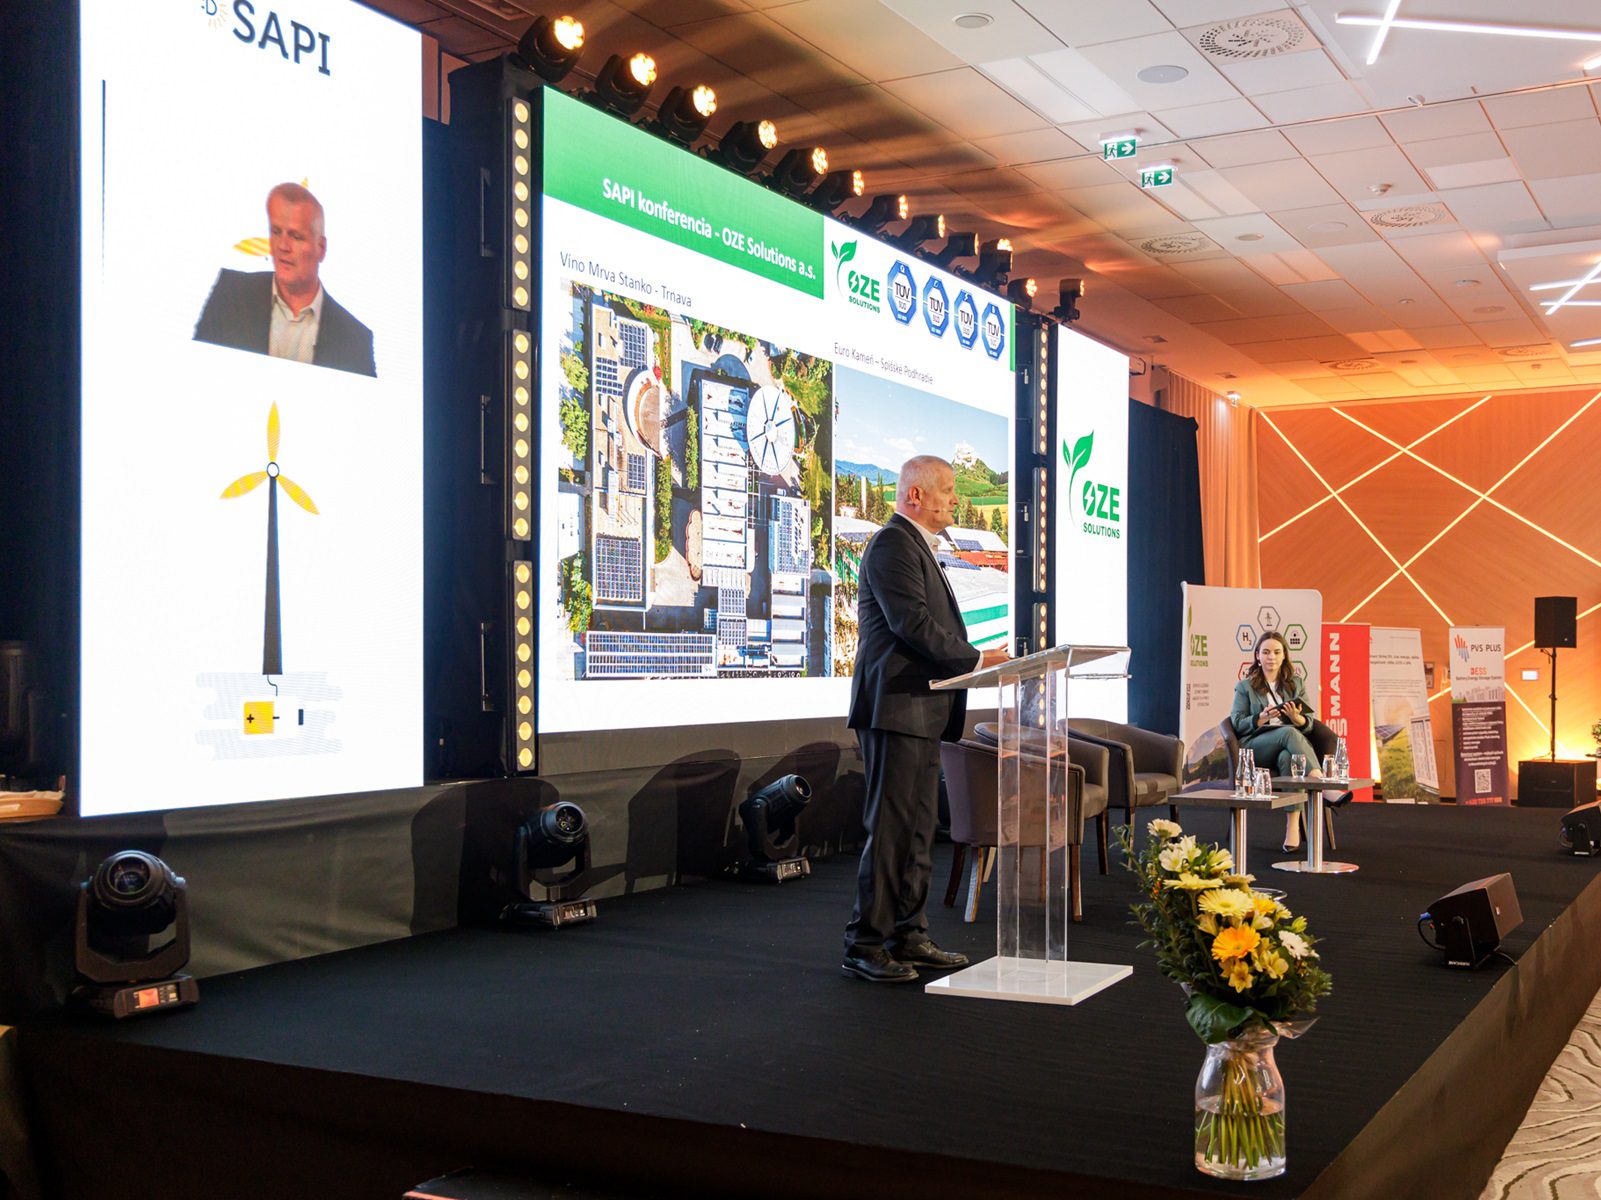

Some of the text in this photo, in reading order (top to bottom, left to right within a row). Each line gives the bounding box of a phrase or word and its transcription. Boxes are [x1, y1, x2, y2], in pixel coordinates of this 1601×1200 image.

[232, 0, 331, 76] SAPI
[602, 178, 635, 208] SAPI
[638, 191, 712, 239] konferencia
[722, 227, 745, 252] OZE
[747, 237, 797, 272] Solutions
[799, 261, 816, 280] a.s.
[589, 261, 616, 283] Mrva
[619, 271, 652, 294] Stanko
[661, 285, 692, 307] Trnava
[848, 270, 880, 302] OZE
[849, 295, 881, 313] SOLUTIONS
[834, 342, 850, 358] Euro
[1083, 480, 1120, 522] OZE
[1083, 522, 1120, 539] SOLUTIONS
[1471, 644, 1501, 652] PVS PLUS
